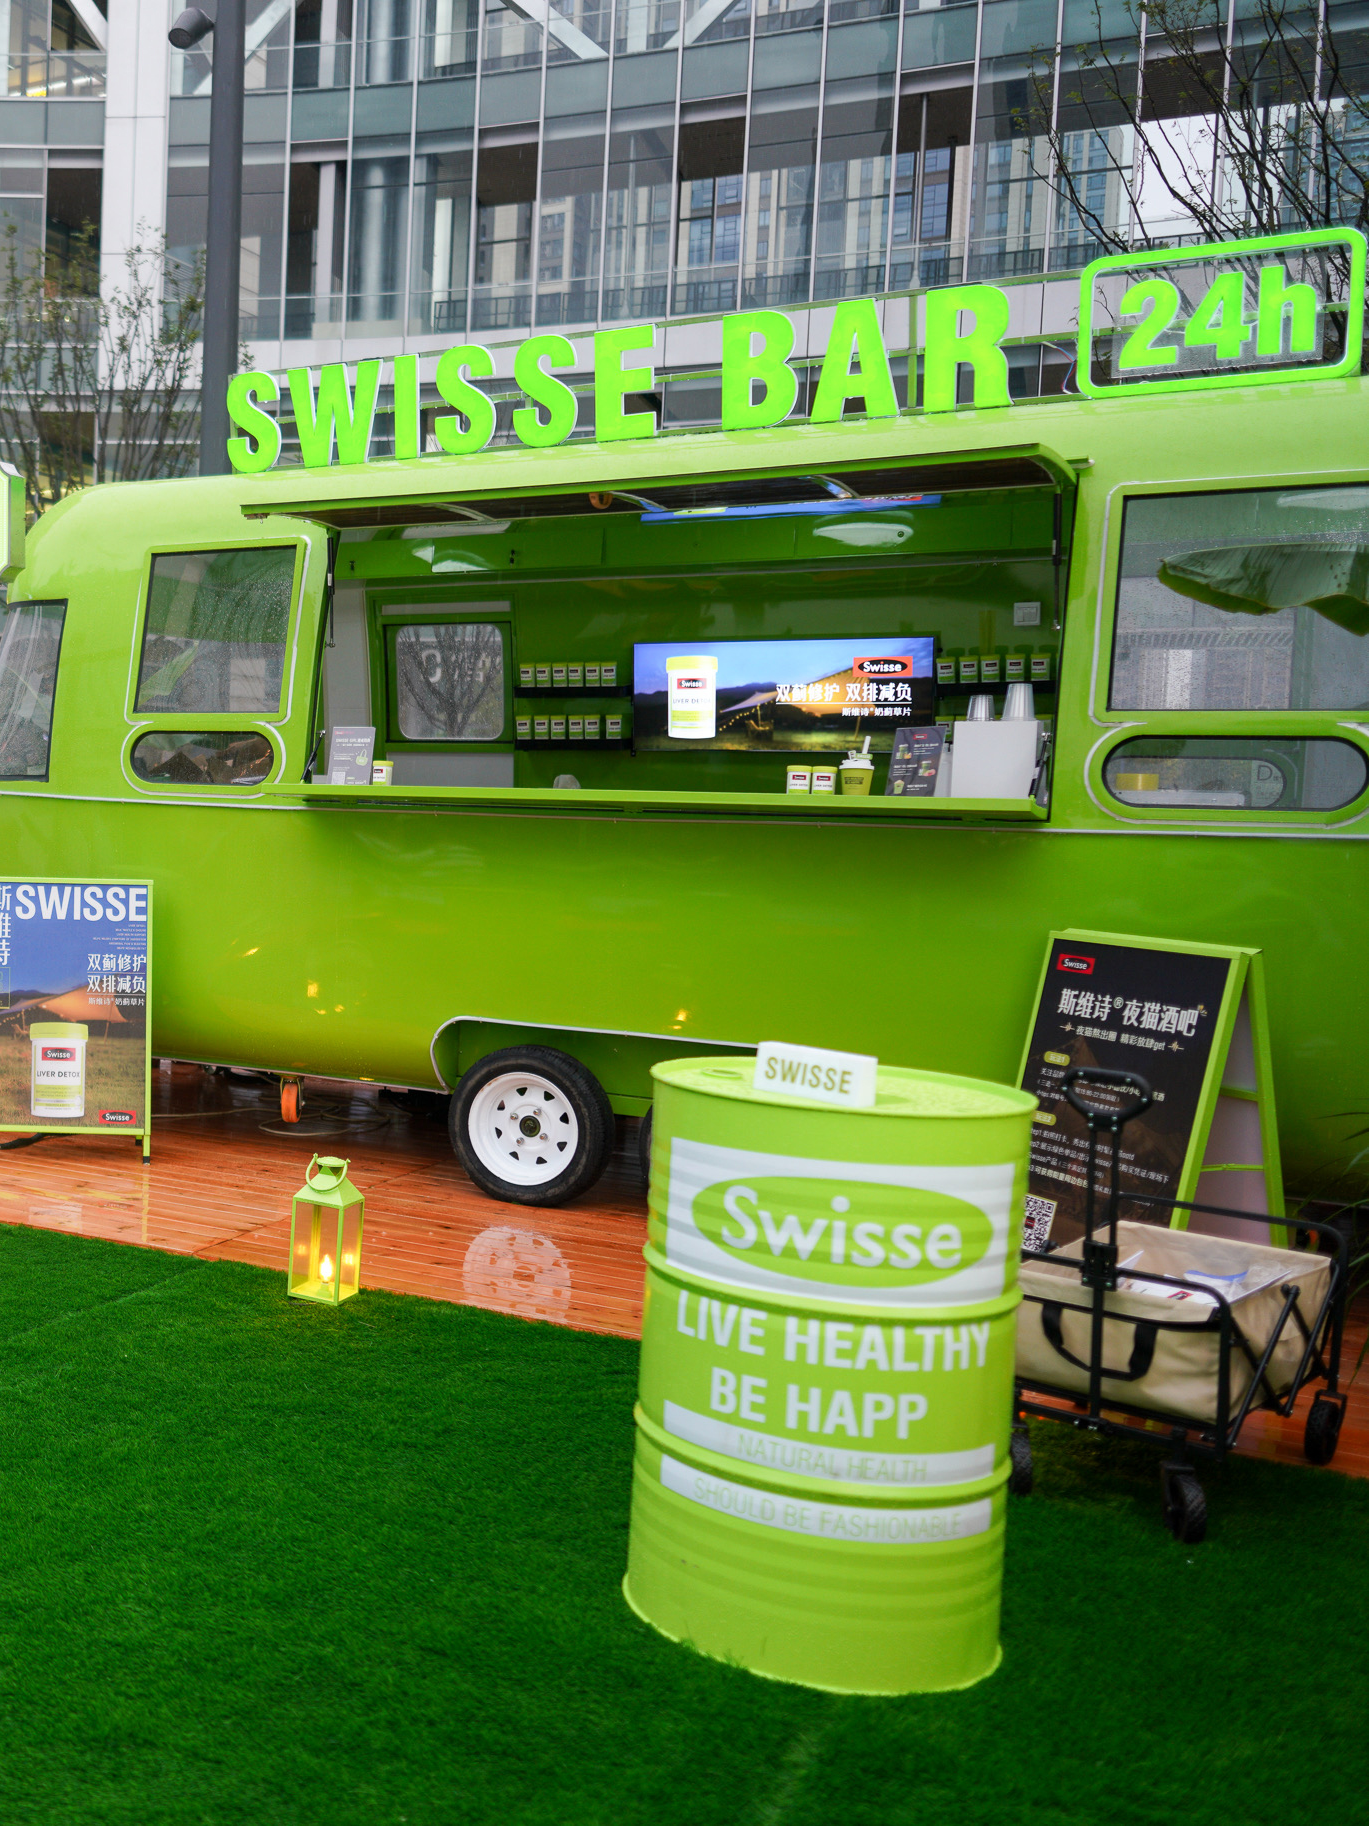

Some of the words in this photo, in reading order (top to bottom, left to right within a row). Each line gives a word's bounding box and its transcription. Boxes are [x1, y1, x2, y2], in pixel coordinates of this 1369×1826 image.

[226, 323, 658, 474] SWISSE
[722, 283, 1013, 431] BAR
[1118, 265, 1318, 371] 24h
[862, 661, 902, 673] Swisse
[680, 680, 703, 688] Swisse
[776, 683, 840, 702] 双蓟修护
[845, 682, 912, 702] 双排减负
[15, 884, 148, 922] SWISSE
[87, 953, 147, 972] 双蓟修护
[1062, 958, 1088, 970] Swisse
[86, 974, 146, 994] 双排减负
[46, 1050, 71, 1059] Swisse
[36, 1070, 56, 1078] LIVER
[57, 1070, 81, 1079] DETOX
[764, 1056, 854, 1095] SWISSE
[105, 1112, 130, 1122] Swisse
[721, 1184, 963, 1270] Swisse
[676, 1289, 768, 1357] LIVE
[784, 1316, 991, 1372] HEALTHY
[709, 1366, 768, 1424] BE
[785, 1383, 929, 1440] HAPP
[736, 1434, 839, 1478] NATURAL
[846, 1457, 929, 1483] HEALTH
[693, 1477, 776, 1522] SHOULD
[783, 1508, 813, 1530] BE
[818, 1510, 963, 1541] FASHIONABLE
